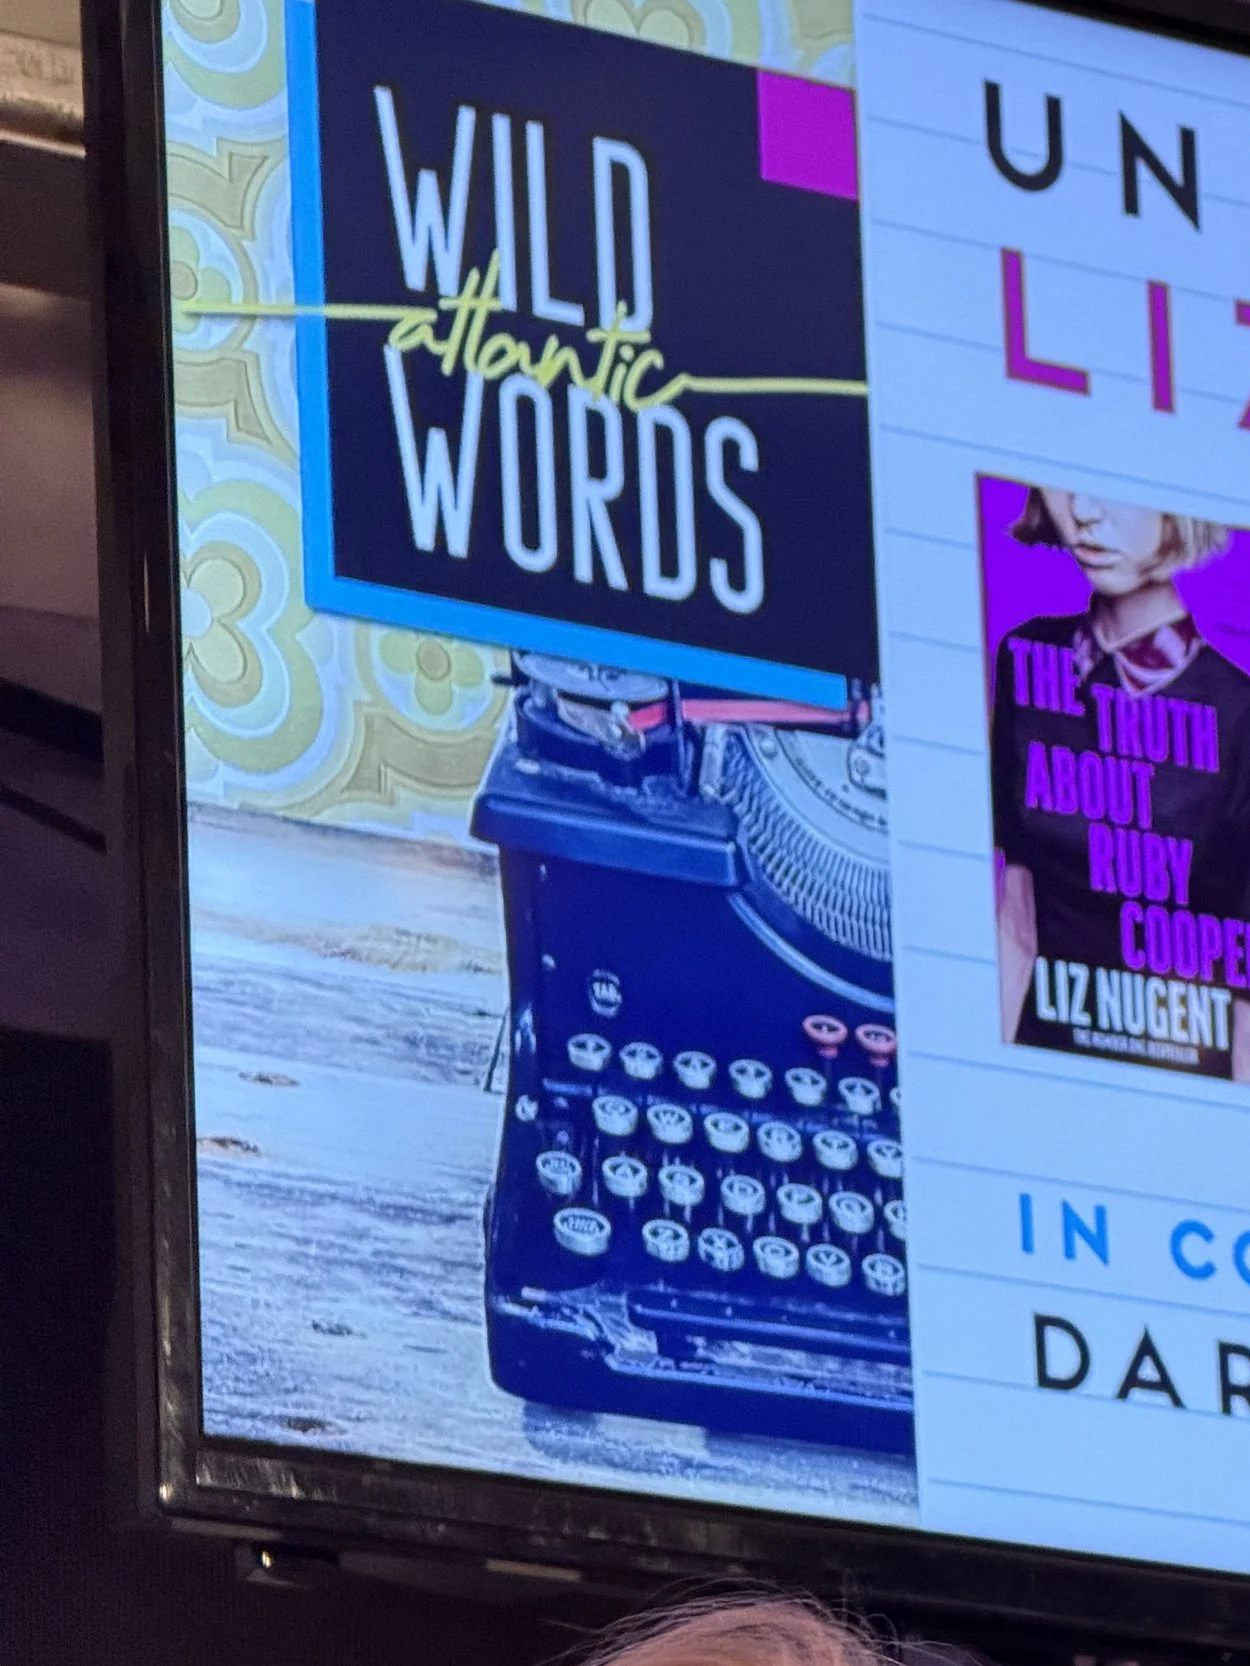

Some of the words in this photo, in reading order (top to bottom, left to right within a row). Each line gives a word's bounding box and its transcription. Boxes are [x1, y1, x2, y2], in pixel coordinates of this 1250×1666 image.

[373, 85, 653, 333] WILD
[388, 249, 690, 412] atlantic
[383, 344, 765, 614] WORDS
[1008, 637, 1087, 718] THE
[1091, 683, 1219, 773] TRUTH
[1025, 741, 1155, 830] ABOUT
[1088, 822, 1193, 906] RUBY
[1034, 955, 1092, 1028] LIZ
[1095, 966, 1232, 1052] NUGENT
[1018, 1192, 1110, 1266] IN
